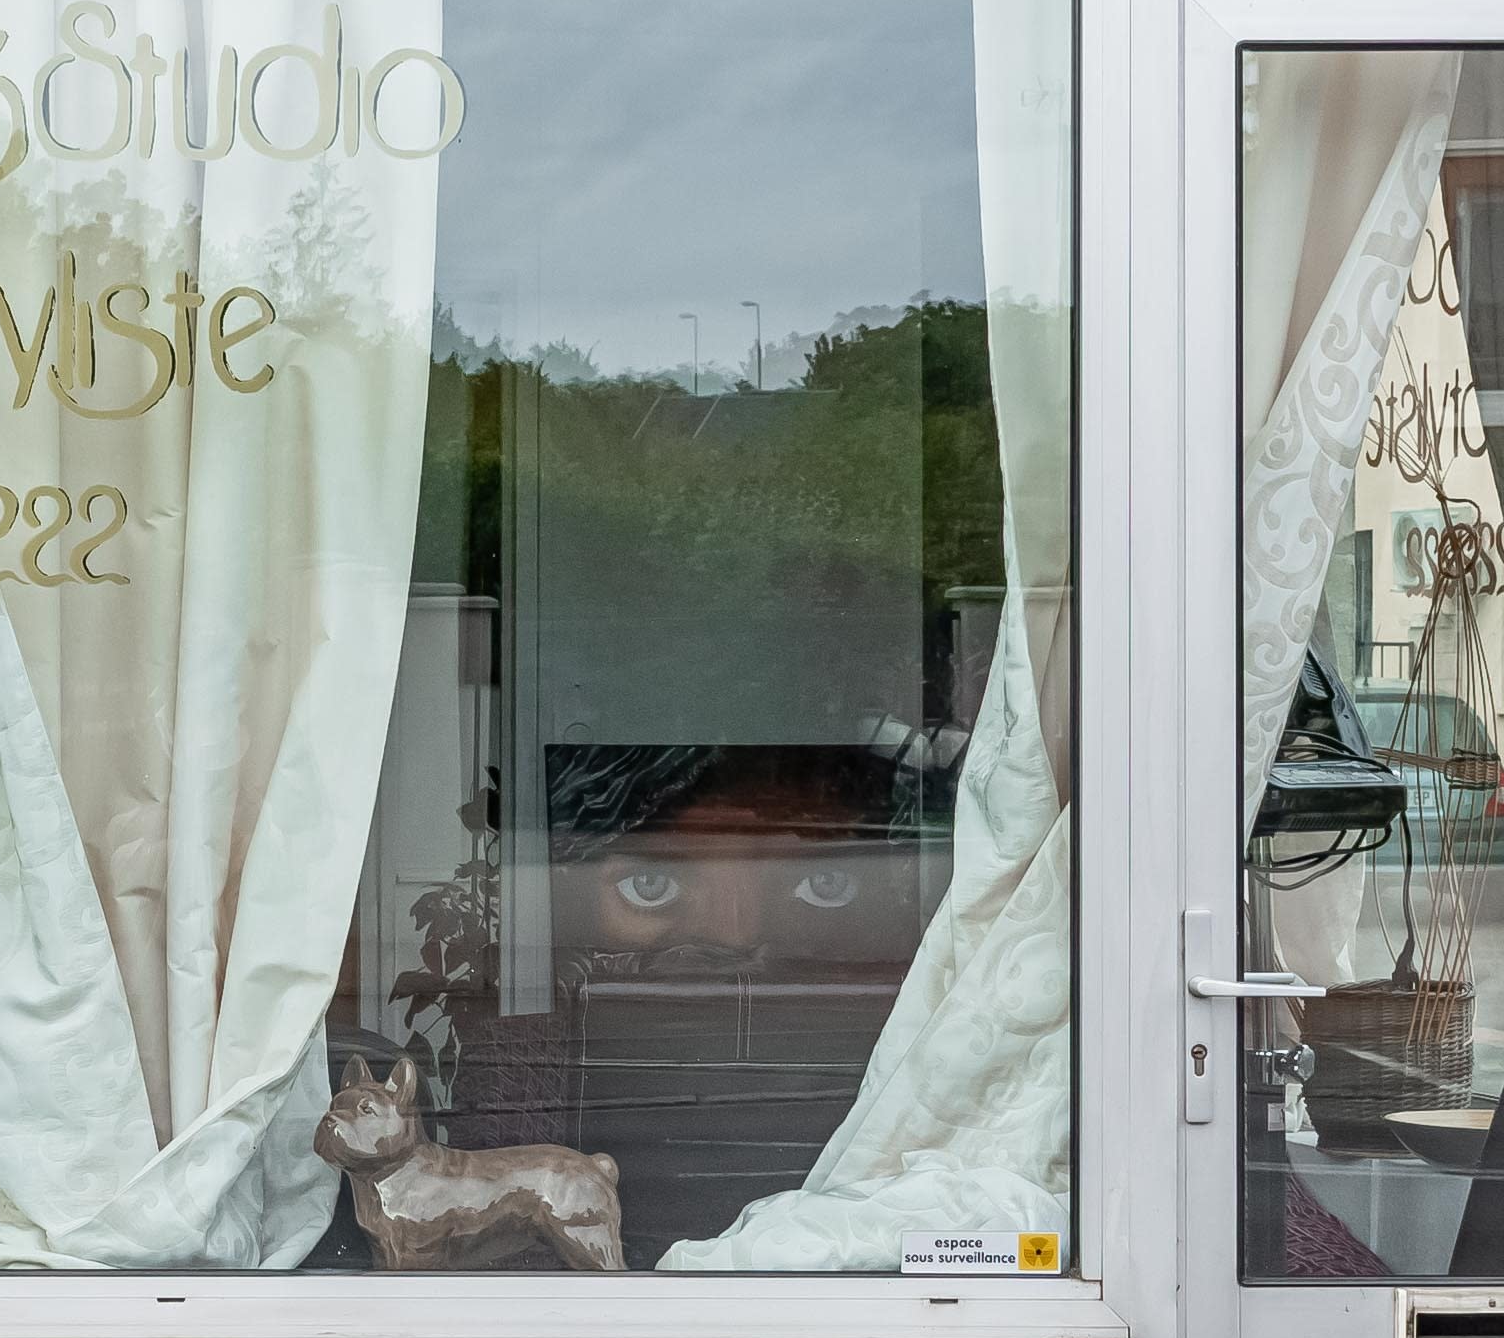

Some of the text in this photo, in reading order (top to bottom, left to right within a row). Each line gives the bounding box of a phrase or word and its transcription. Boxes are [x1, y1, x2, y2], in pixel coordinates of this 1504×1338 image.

[934, 1238, 983, 1251] espace
[904, 1251, 1016, 1264] sous surveillance
